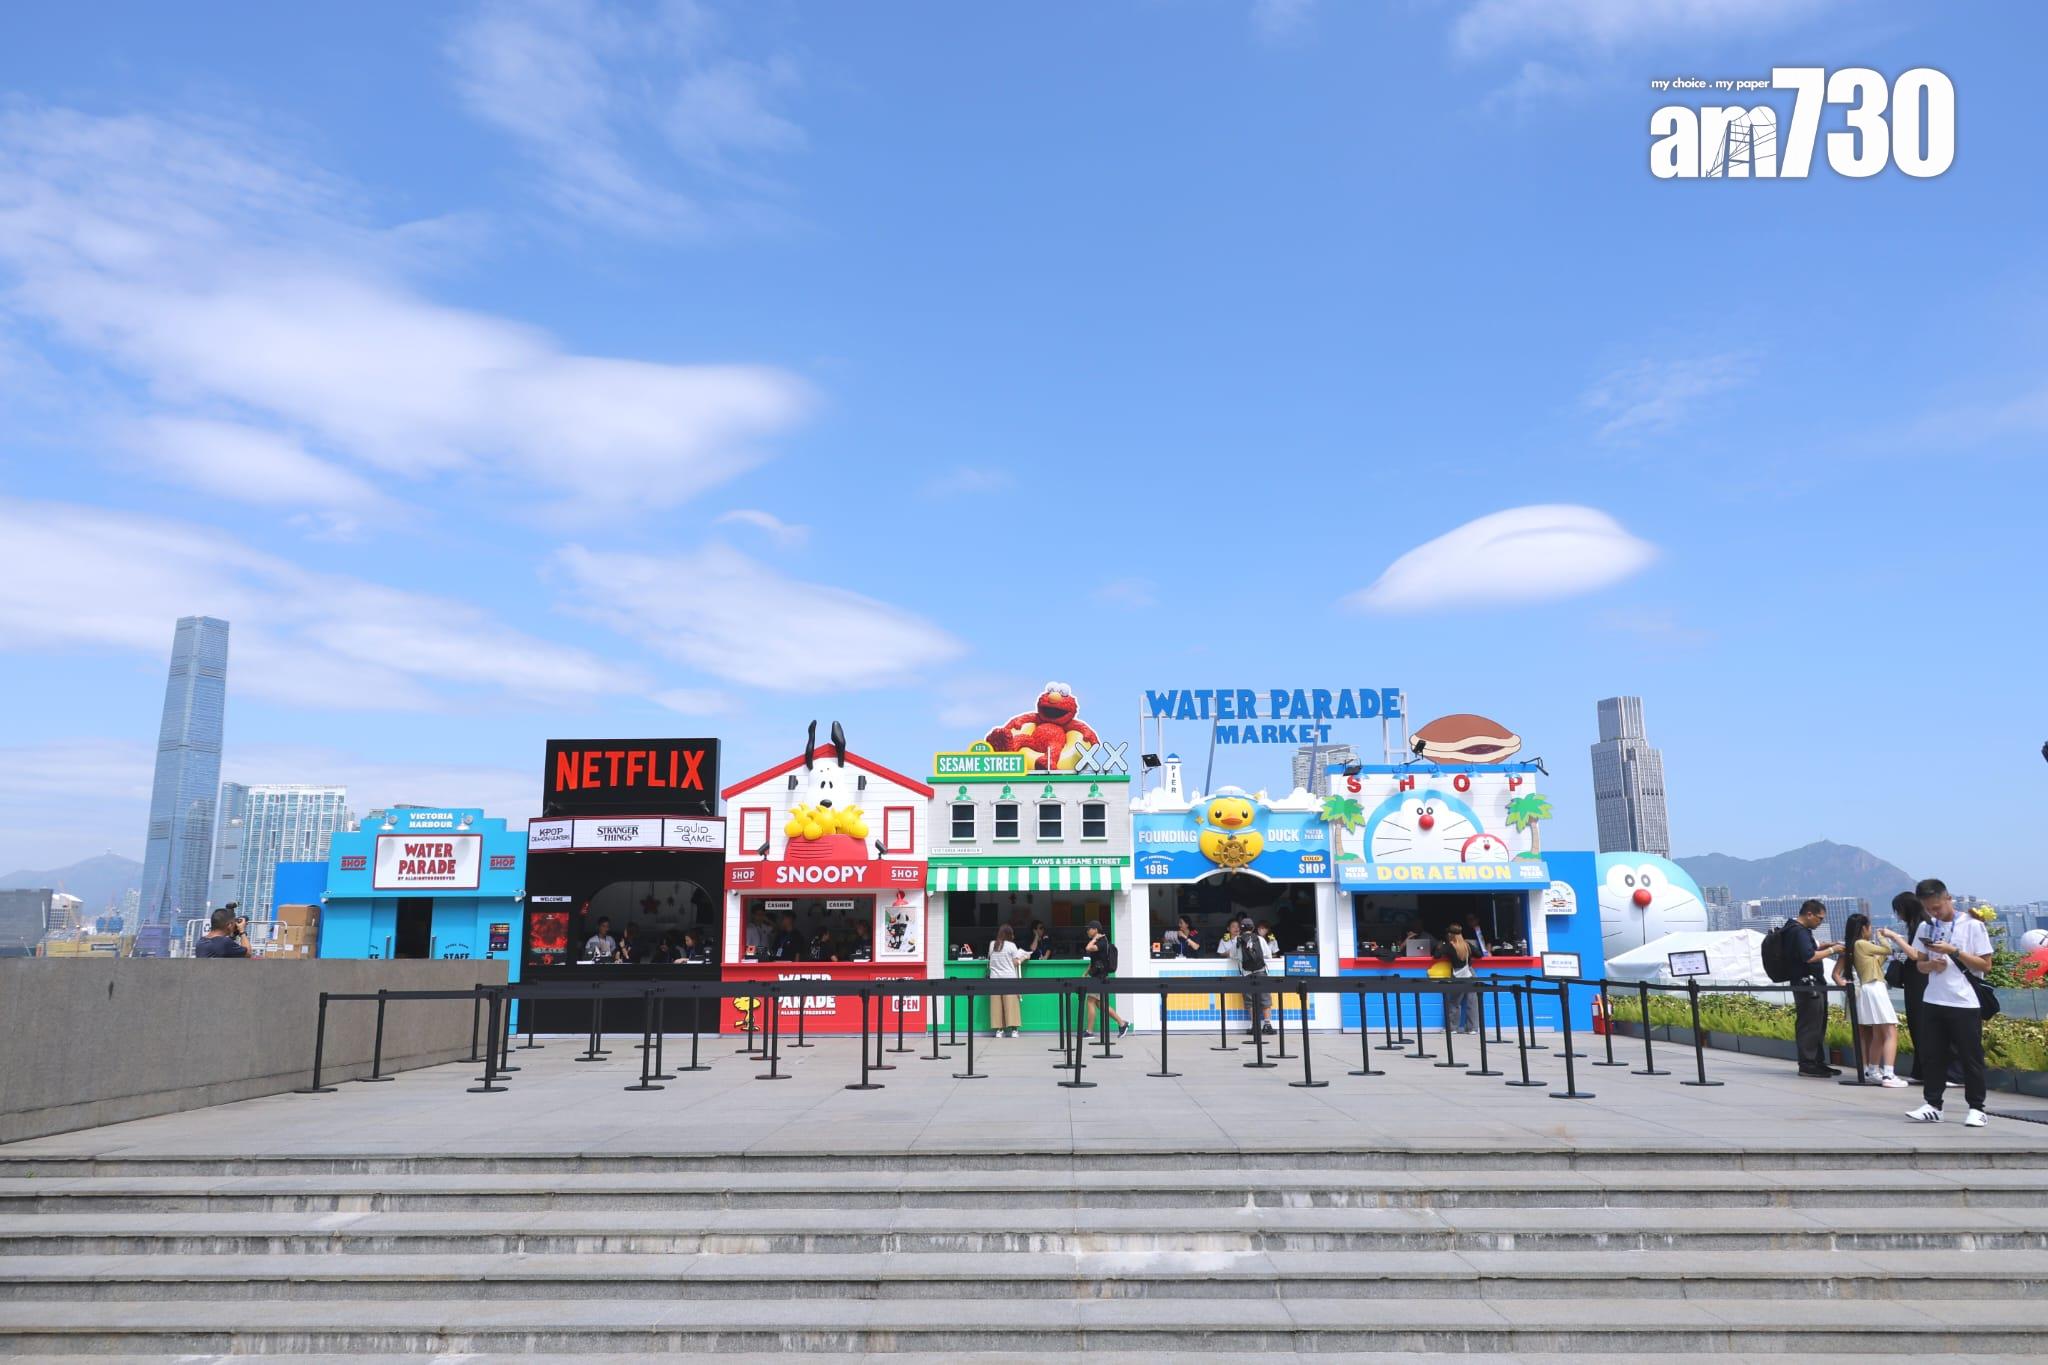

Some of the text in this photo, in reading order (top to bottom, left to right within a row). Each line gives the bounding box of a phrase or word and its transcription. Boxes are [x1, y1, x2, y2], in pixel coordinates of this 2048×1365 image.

[1146, 687, 1401, 720] WATER PARADE
[1216, 724, 1332, 744] MARKET
[939, 756, 1022, 772] SESAME STREET
[556, 750, 705, 792] NETFLIX
[597, 825, 639, 836] STRANGER
[674, 823, 709, 837] SQUID
[603, 834, 633, 842] THINGS
[681, 835, 716, 845] GAME
[1138, 829, 1300, 844] FOUNDING DUCK
[404, 843, 454, 858] WATER
[341, 859, 367, 867] SHOP
[398, 859, 457, 875] PARADE
[490, 858, 515, 867] SHOP
[1093, 857, 1121, 865] STREET
[776, 865, 868, 884] SNOOPY
[891, 869, 919, 878] SHOP
[1144, 864, 1169, 875] 1985
[1298, 863, 1327, 874] SHOP
[1377, 864, 1512, 881] DORAEMON
[732, 871, 755, 880] SHOP
